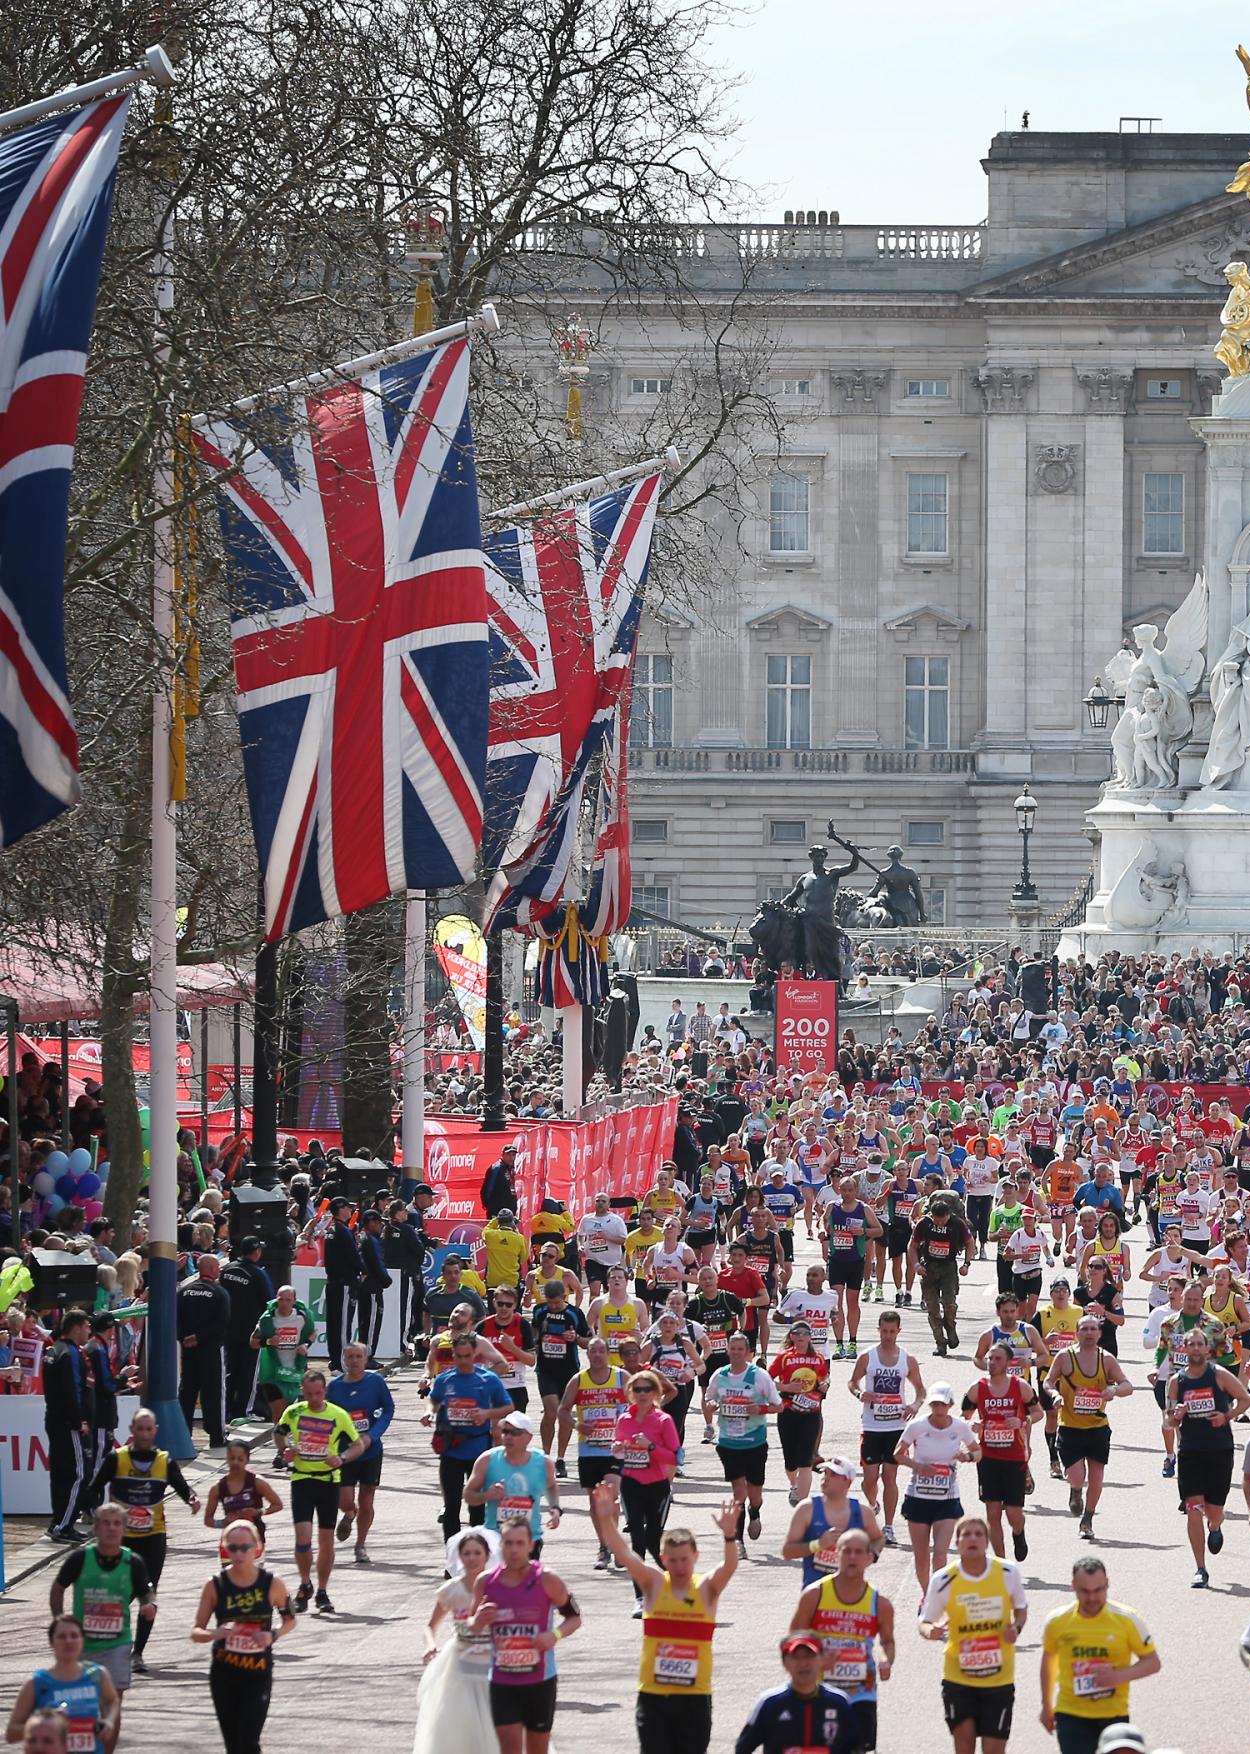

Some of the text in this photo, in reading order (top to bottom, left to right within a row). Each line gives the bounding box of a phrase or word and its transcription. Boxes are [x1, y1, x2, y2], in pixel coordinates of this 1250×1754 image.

[782, 1018, 829, 1036] 200
[783, 1039, 827, 1047] METRES
[788, 1050, 823, 1058] TO GO
[450, 1154, 475, 1170] money
[450, 1200, 475, 1217] money
[223, 1273, 249, 1285] STEWARD
[183, 1288, 213, 1298] STEWARD
[806, 1310, 827, 1319] RAJ
[876, 1369, 901, 1377] DAVE
[984, 1399, 1013, 1407] BOBBY
[1075, 1396, 1101, 1406] 53856
[1186, 1399, 1213, 1410] 18593
[878, 1404, 899, 1413] 4984
[985, 1430, 1013, 1439] 53132
[226, 1635, 257, 1650] 4182
[1072, 1647, 1109, 1659] SHEA
[660, 1660, 692, 1675] 6662
[832, 1663, 861, 1677] 205
